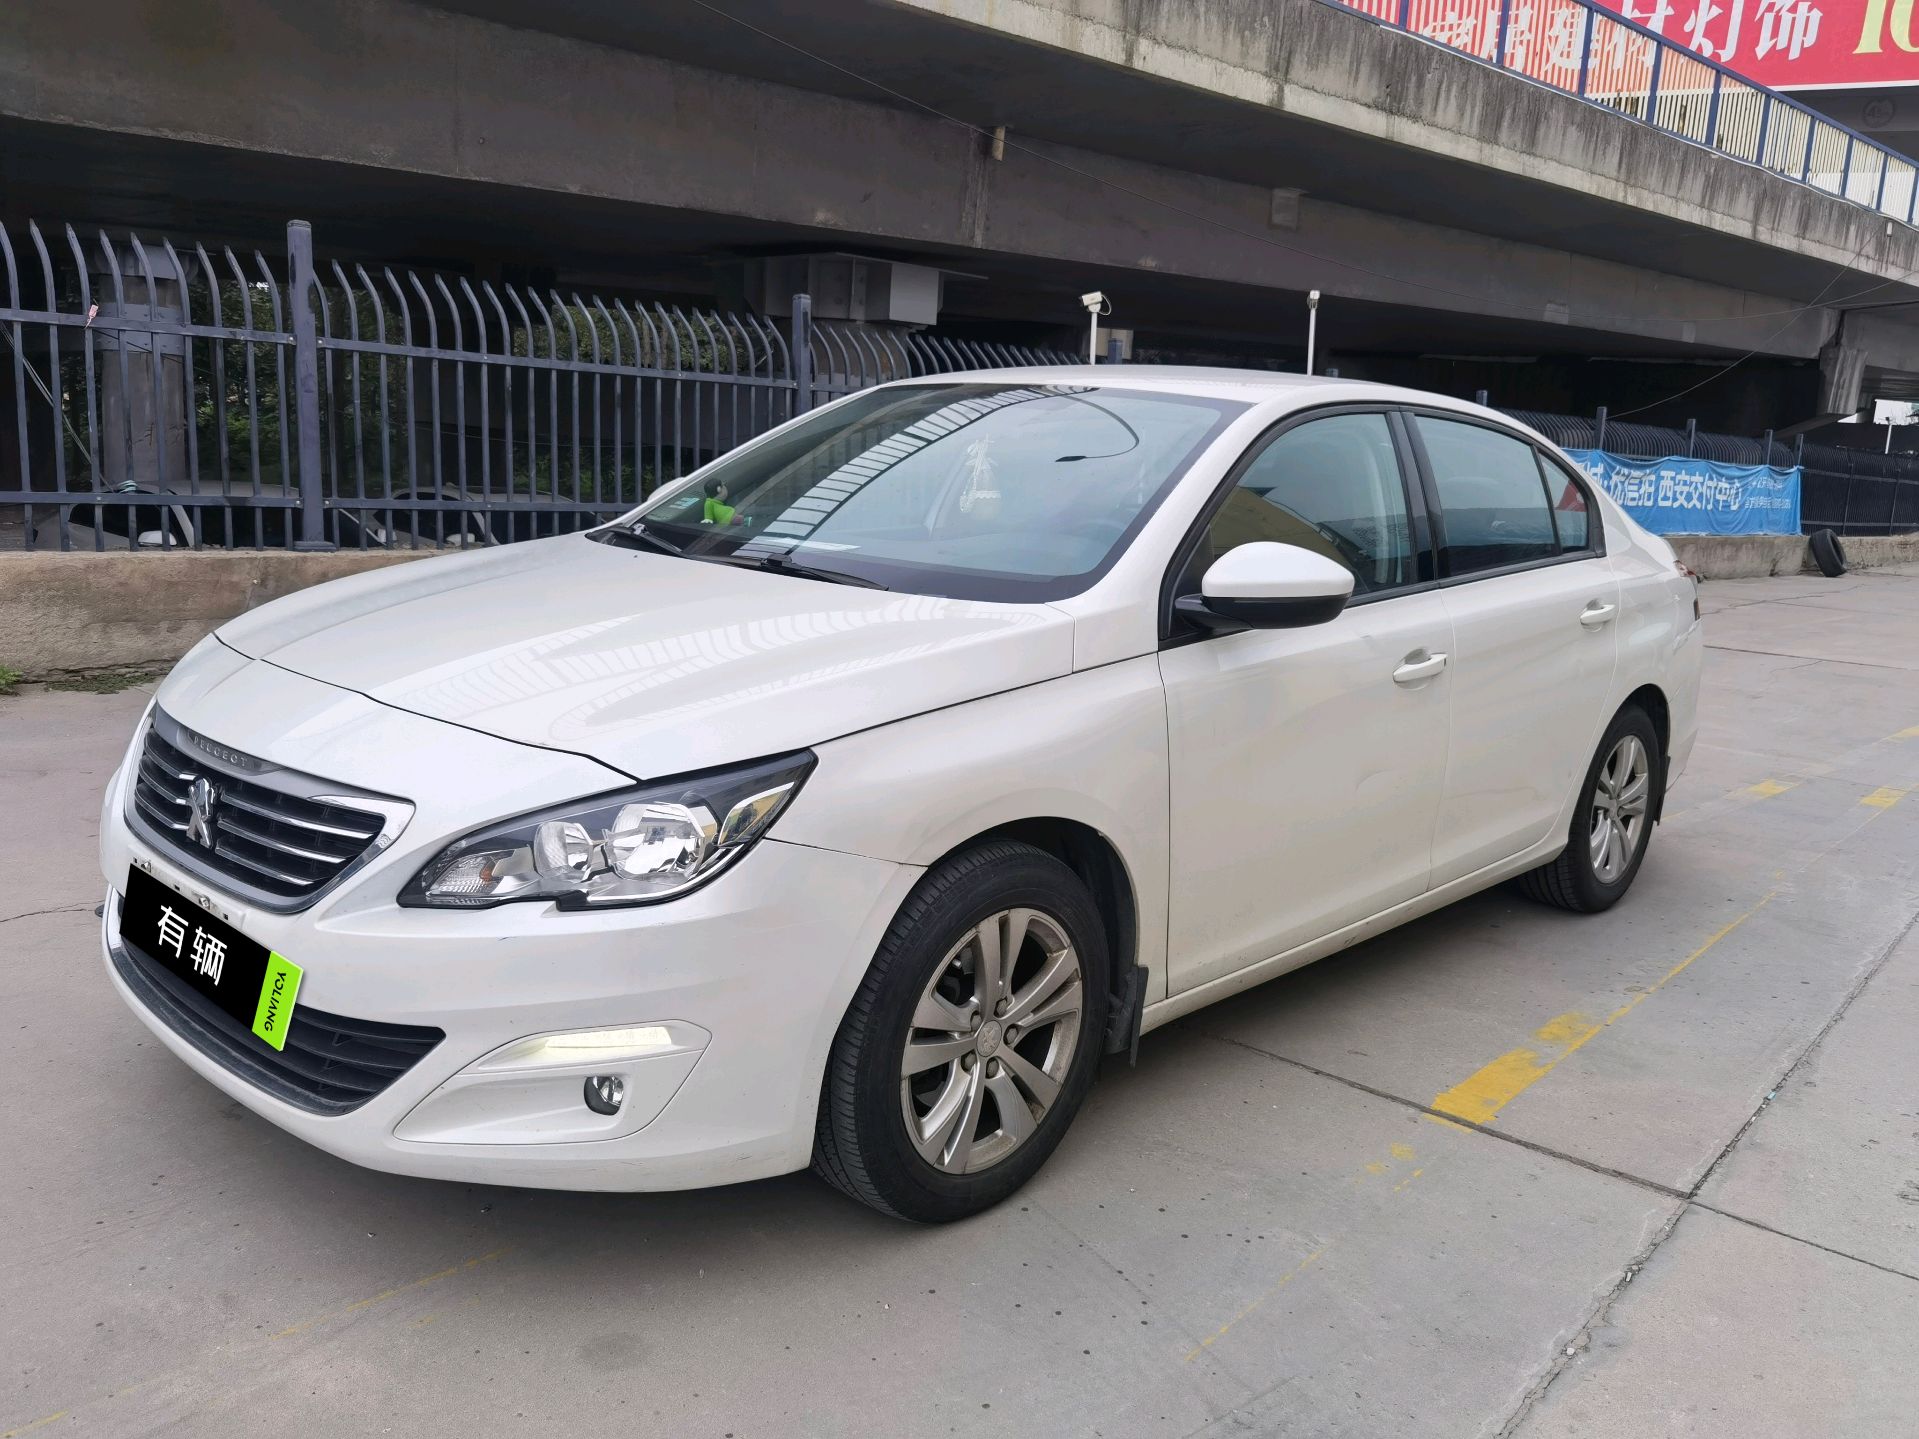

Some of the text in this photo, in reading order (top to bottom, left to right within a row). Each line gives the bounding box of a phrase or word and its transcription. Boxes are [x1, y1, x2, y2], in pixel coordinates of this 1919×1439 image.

[1658, 470, 1742, 511] 西安交付中心
